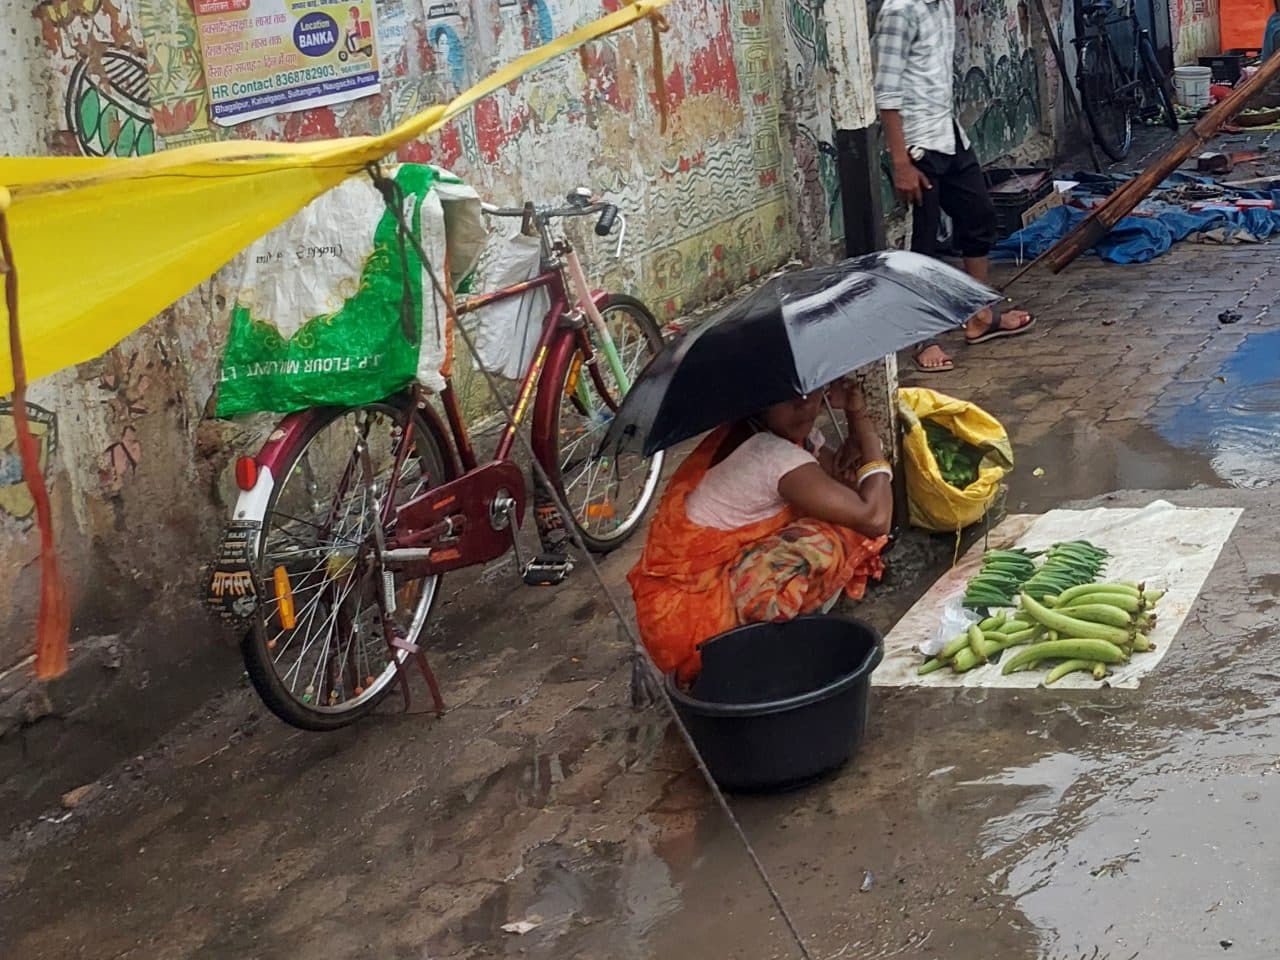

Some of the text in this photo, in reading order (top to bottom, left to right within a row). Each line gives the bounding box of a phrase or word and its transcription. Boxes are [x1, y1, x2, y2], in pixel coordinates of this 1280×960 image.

[300, 19, 330, 32] Location
[299, 32, 334, 48] BANKA
[212, 86, 229, 100] HR
[231, 79, 273, 96] Contact
[304, 357, 350, 373] FLOUR
